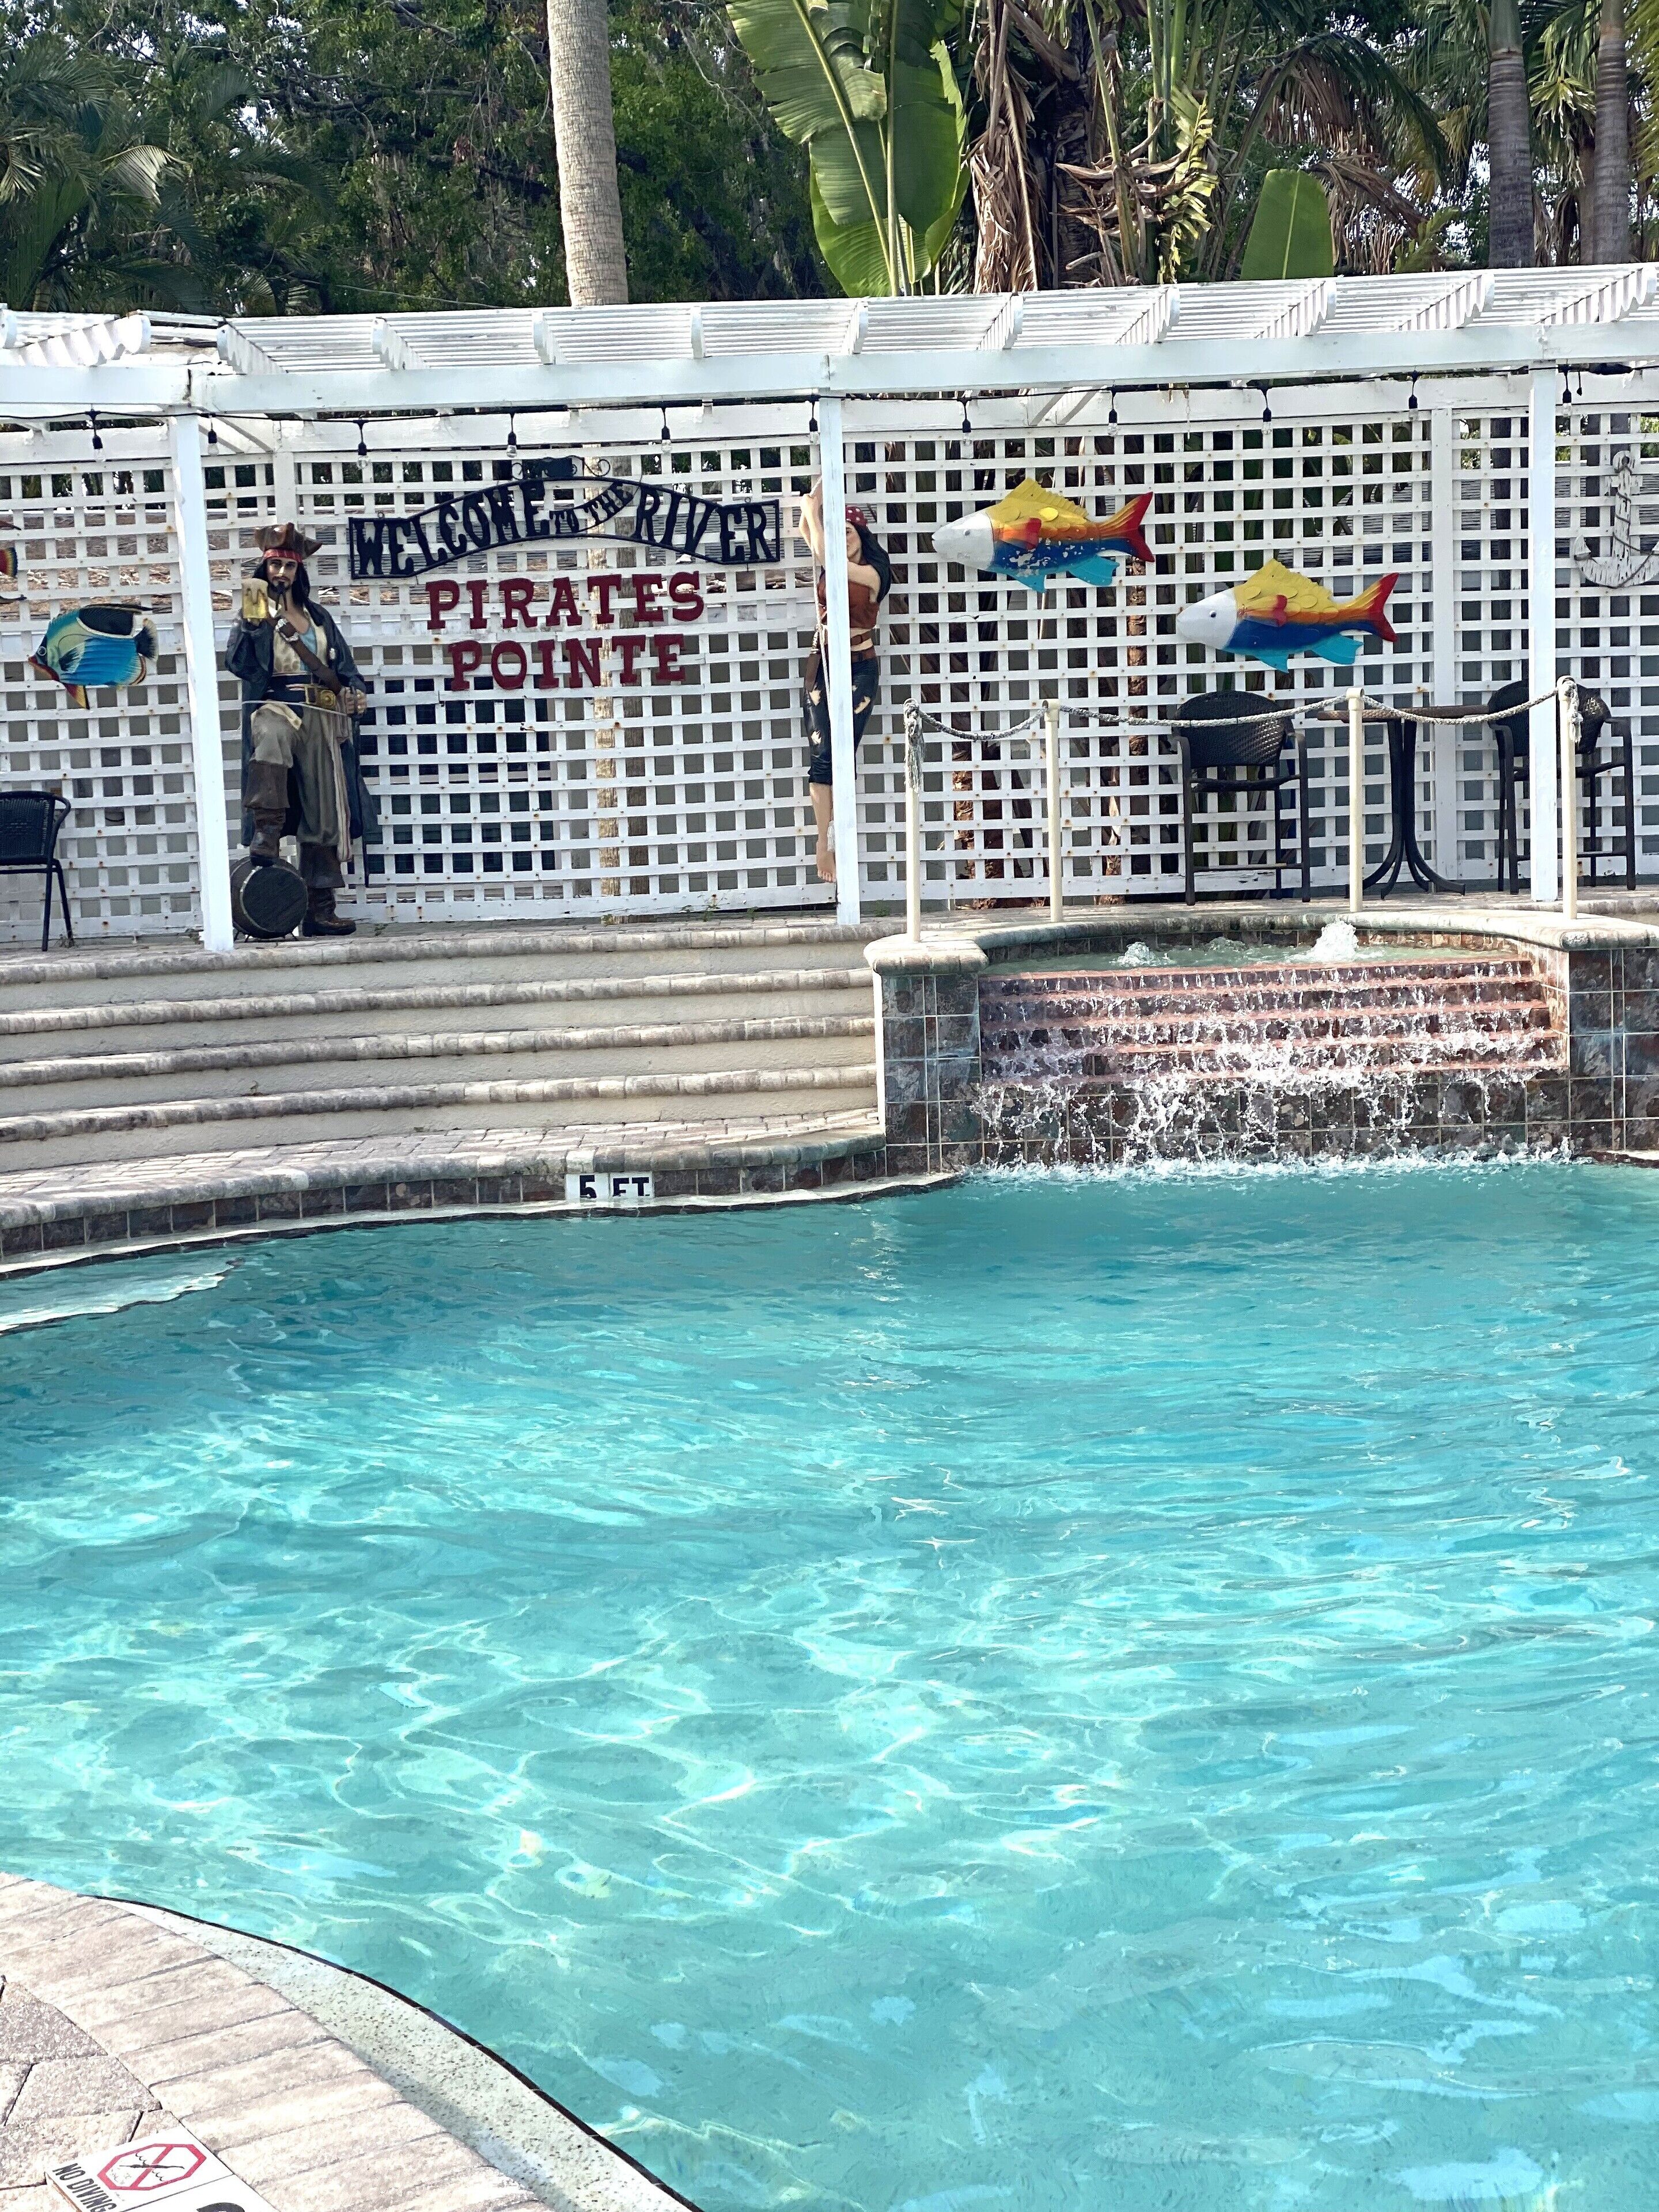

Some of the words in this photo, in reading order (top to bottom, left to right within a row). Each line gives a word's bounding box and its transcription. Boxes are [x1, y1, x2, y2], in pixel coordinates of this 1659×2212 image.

[356, 479, 550, 575] WELCOME
[549, 509, 579, 533] TO
[583, 483, 634, 526] THE
[634, 484, 775, 562] RIVER
[425, 570, 704, 630] PIRATES
[448, 634, 685, 691] POINTE
[579, 1175, 597, 1199] 5
[52, 2162, 86, 2181] NO
